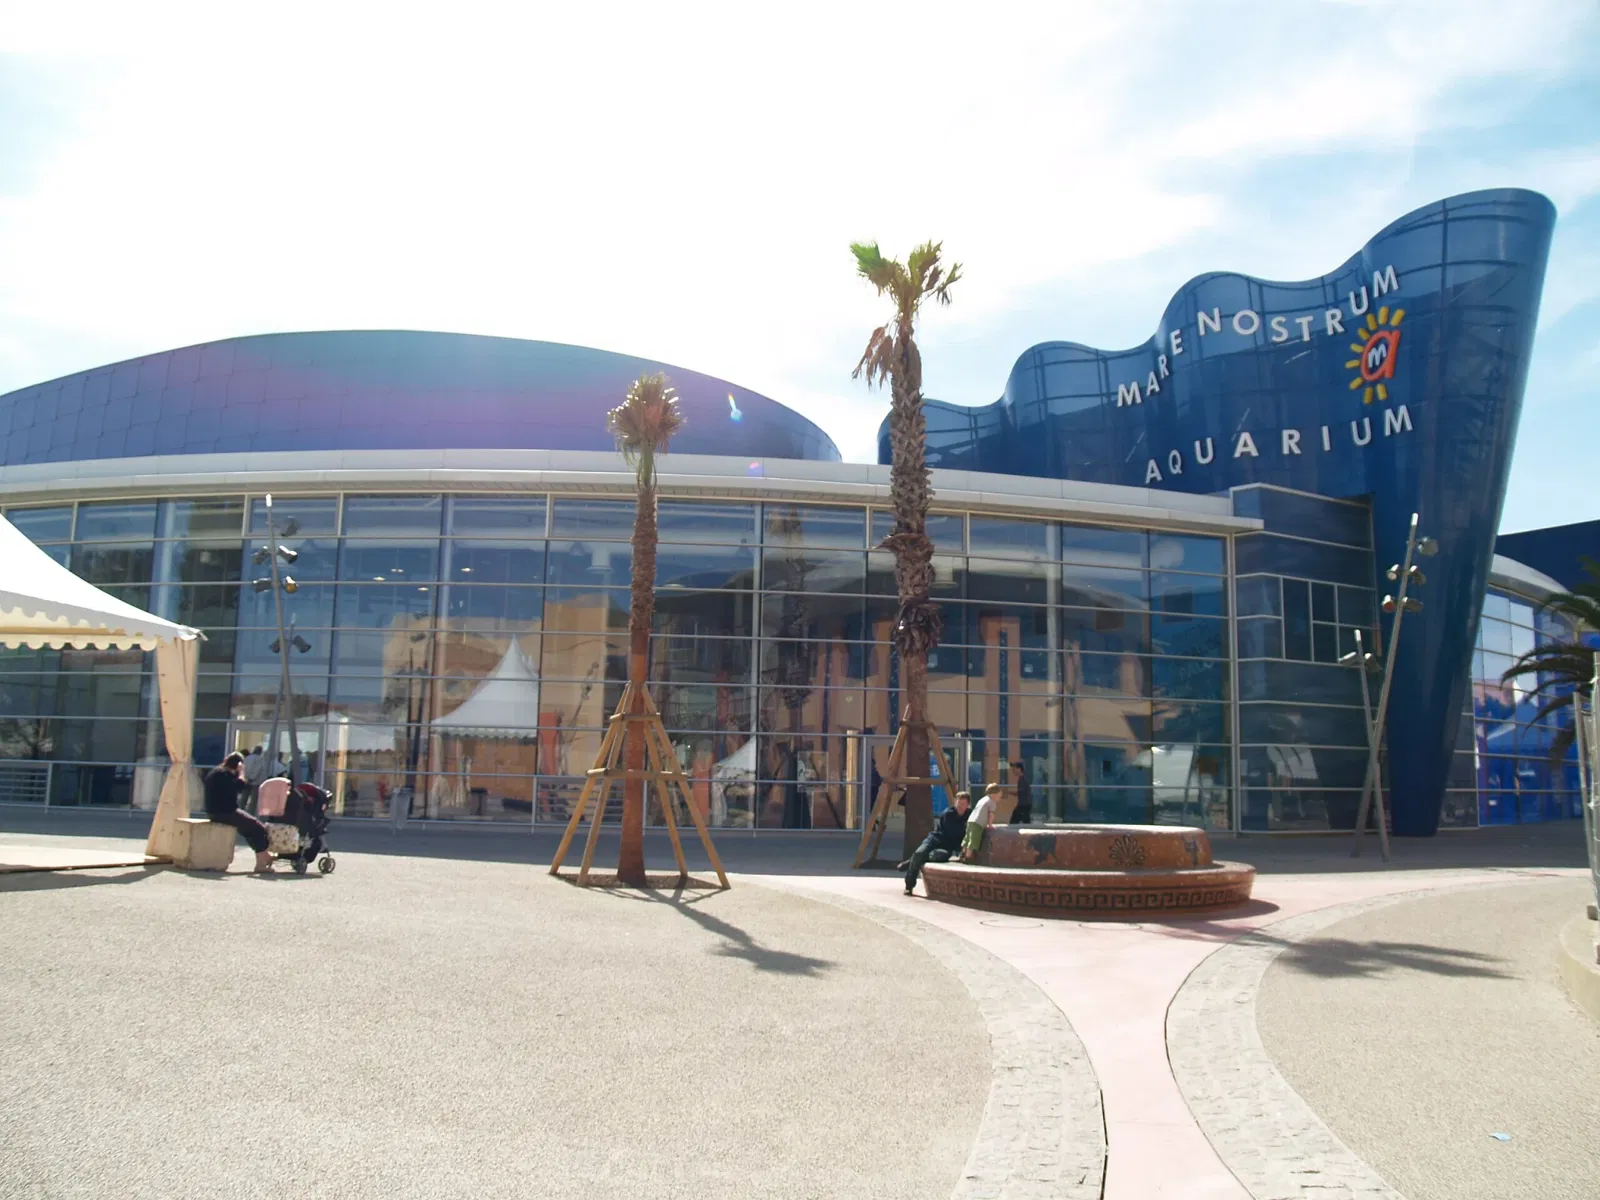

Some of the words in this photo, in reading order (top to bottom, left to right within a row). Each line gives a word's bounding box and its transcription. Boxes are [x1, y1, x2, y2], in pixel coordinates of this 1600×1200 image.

[1117, 329, 1183, 407] MARE
[1197, 264, 1399, 342] NOSTRUM
[1144, 404, 1413, 484] AQUARIUM
